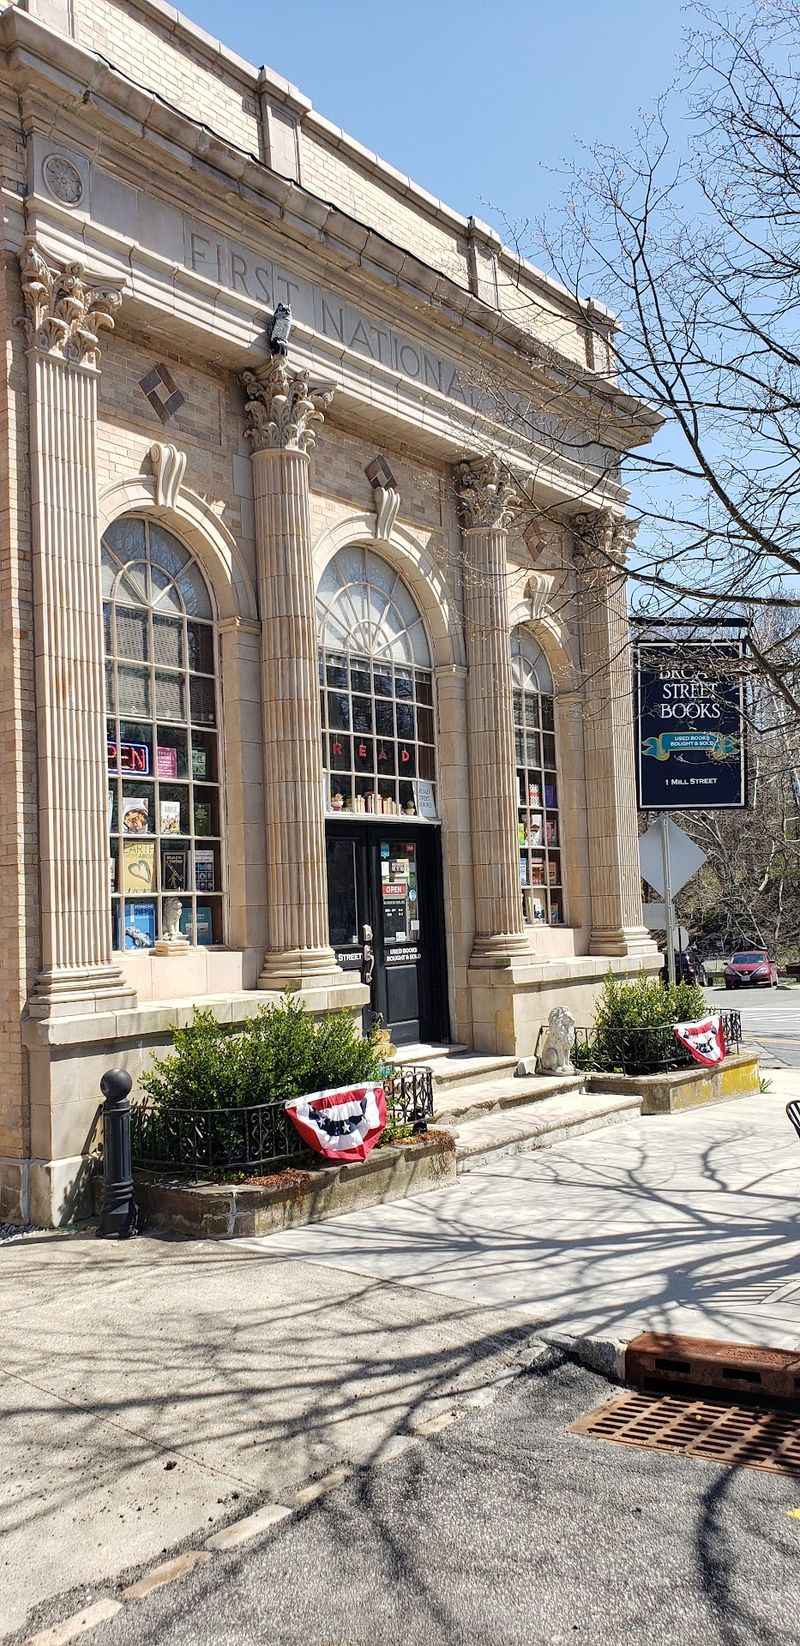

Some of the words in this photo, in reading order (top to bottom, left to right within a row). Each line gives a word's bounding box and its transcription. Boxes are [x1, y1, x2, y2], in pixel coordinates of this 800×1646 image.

[191, 232, 299, 306] FIRST
[659, 664, 716, 680] BROA
[662, 683, 718, 699] STREET
[660, 702, 720, 719] BOOKS
[107, 745, 145, 770] PEN
[690, 777, 718, 785] STREET
[385, 885, 405, 894] OPEN
[338, 952, 363, 962] STREET
[389, 948, 402, 956] USED
